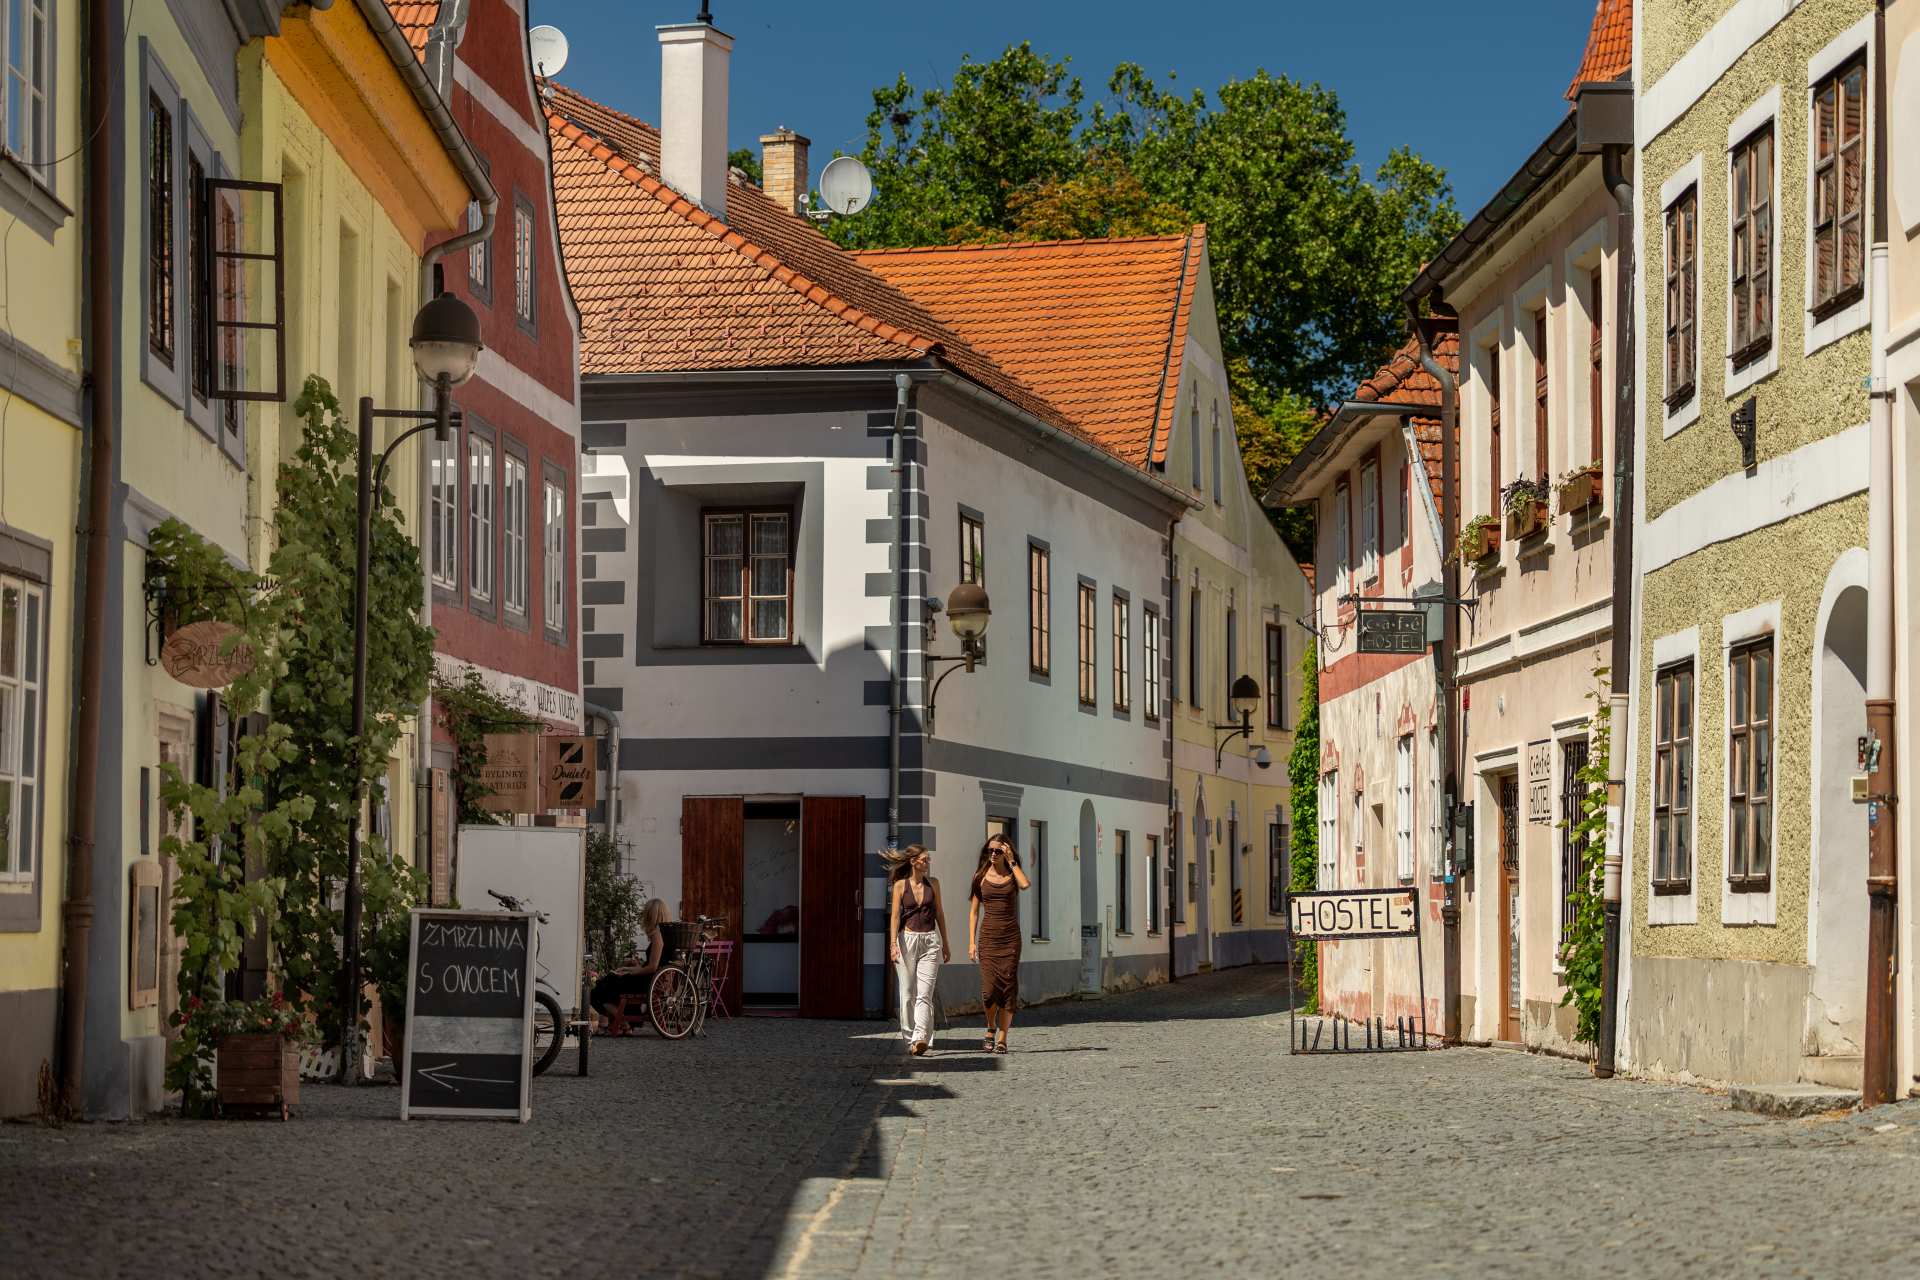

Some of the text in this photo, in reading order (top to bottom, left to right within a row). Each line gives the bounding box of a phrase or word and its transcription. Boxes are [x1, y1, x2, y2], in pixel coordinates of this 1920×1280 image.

[1364, 634, 1419, 649] HOSTEL
[536, 685, 557, 714] VULPES
[558, 693, 576, 720] VULPES
[1529, 784, 1550, 815] HOSTEL
[1297, 898, 1399, 932] HOSTEL
[422, 922, 526, 951] ZMRZLINA
[419, 962, 521, 998] S OVOCEM
